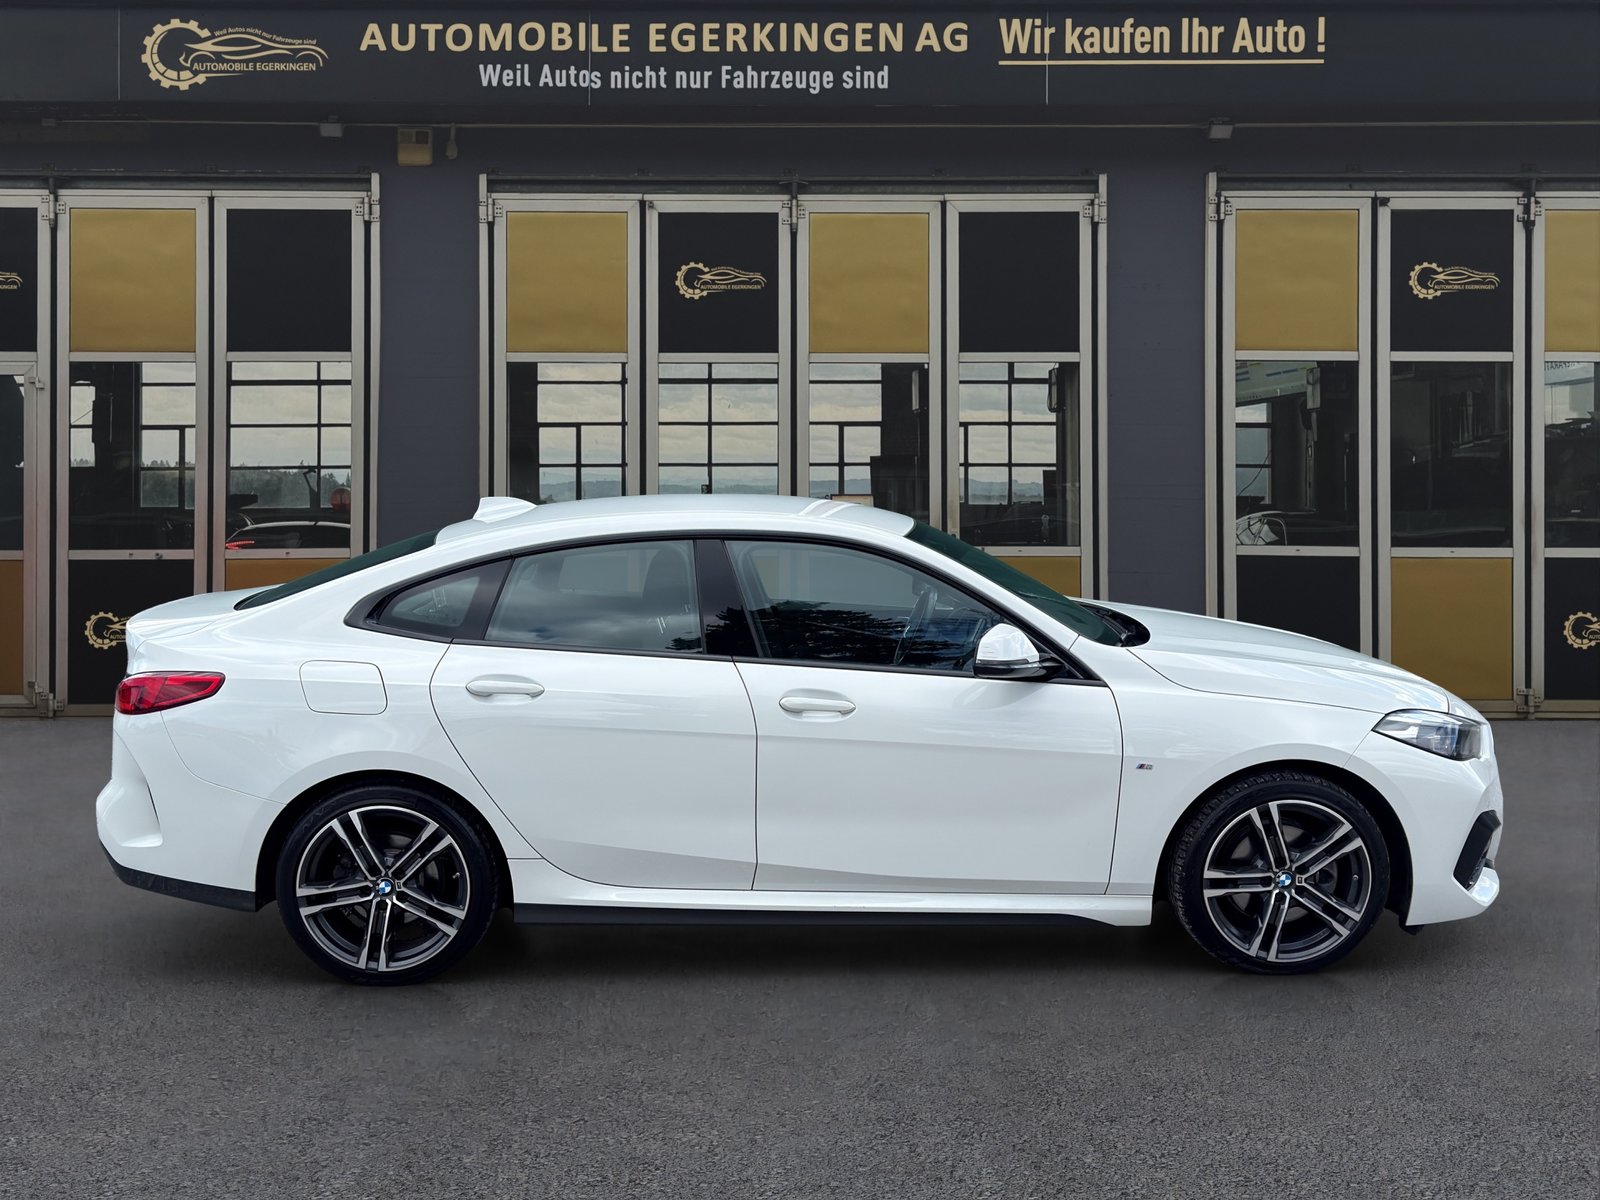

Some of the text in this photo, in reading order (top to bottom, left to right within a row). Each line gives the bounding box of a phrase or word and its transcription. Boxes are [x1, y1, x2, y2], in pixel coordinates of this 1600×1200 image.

[214, 28, 227, 37] Weil
[359, 22, 969, 53] AUTOMOBILE EGERKINGEN AG
[998, 17, 1056, 54] Wir
[1064, 17, 1171, 54] kaufen
[1181, 17, 1225, 54] Ihr
[1231, 17, 1306, 54] Auto
[192, 62, 316, 71] AUTOMOBILE EGERKINGEN
[478, 63, 889, 95] Weil Autos nicht nur Fahrzeuge sind
